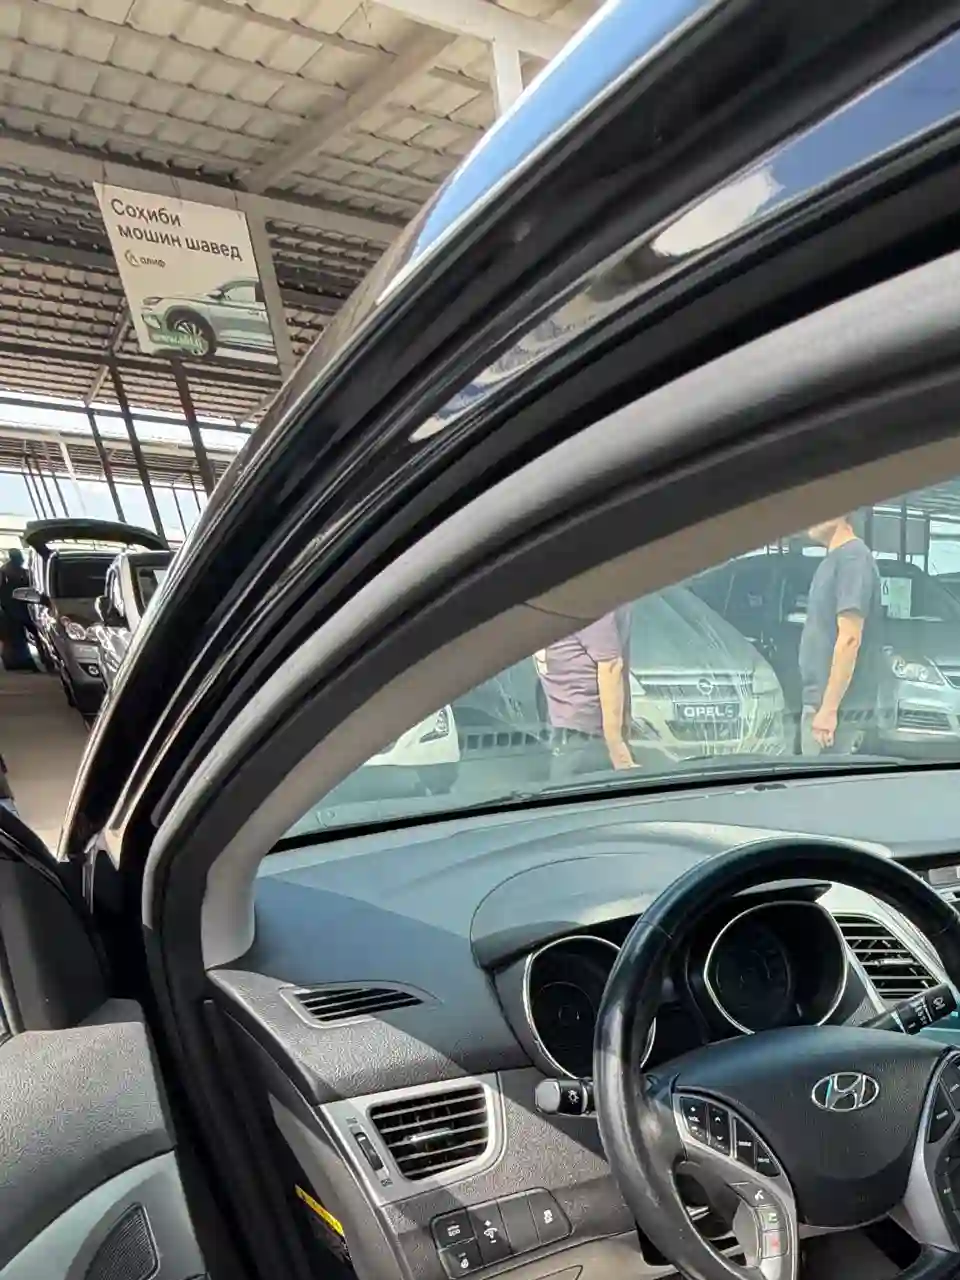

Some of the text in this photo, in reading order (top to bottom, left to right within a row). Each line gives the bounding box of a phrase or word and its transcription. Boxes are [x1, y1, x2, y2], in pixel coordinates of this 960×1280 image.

[111, 198, 181, 227] Соҳиби
[117, 224, 243, 261] мошин шавед
